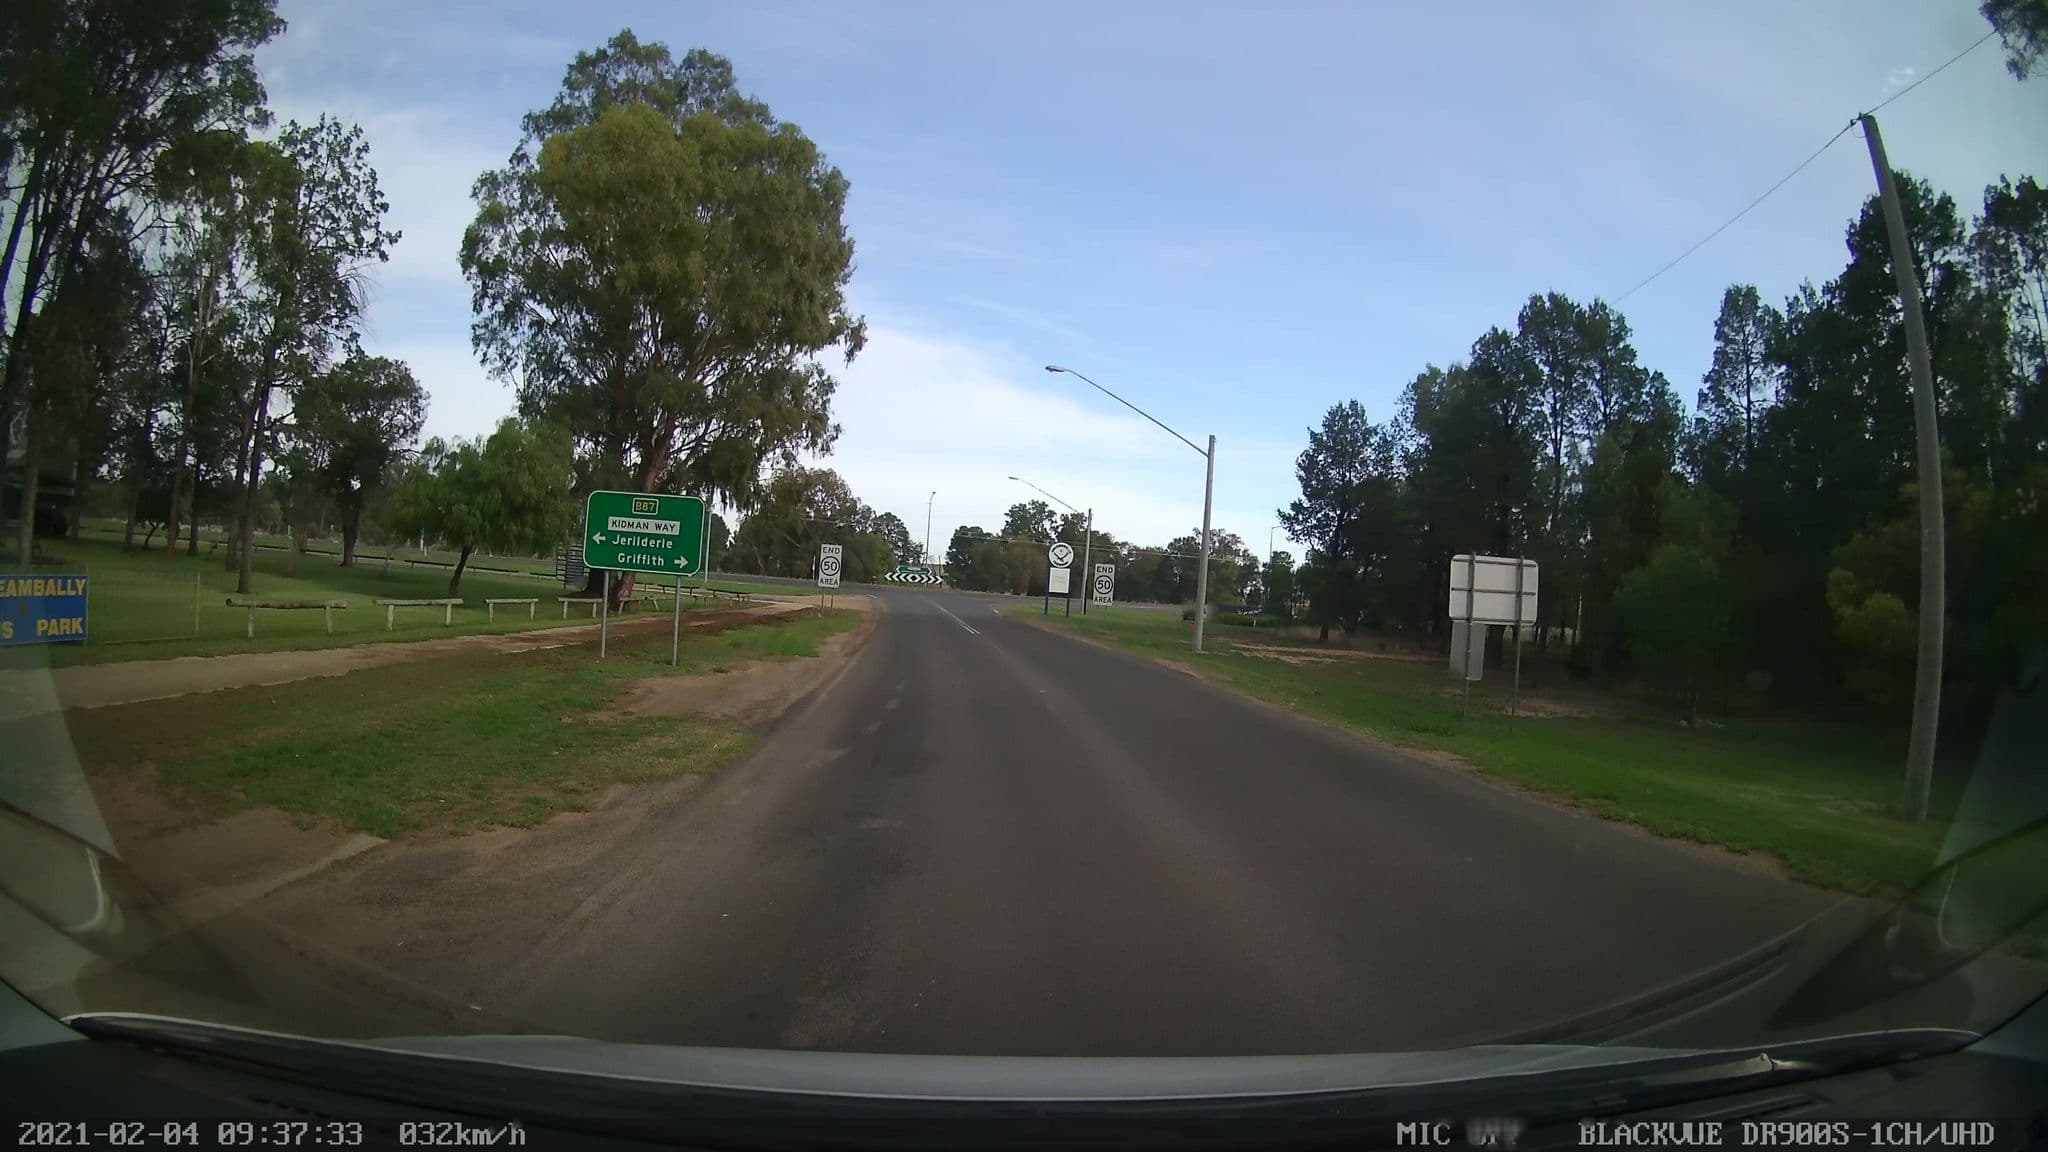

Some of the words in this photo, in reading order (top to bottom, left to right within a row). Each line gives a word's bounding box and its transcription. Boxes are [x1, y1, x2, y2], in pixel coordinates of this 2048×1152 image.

[635, 501, 656, 512] B87
[611, 520, 649, 530] KIDMAN
[654, 523, 676, 532] WAY
[612, 535, 673, 548] Jerilderie
[823, 546, 840, 554] END
[617, 553, 665, 567] Griffith
[824, 561, 837, 571] 50
[1097, 580, 1111, 590] 50
[36, 618, 84, 637] PARK
